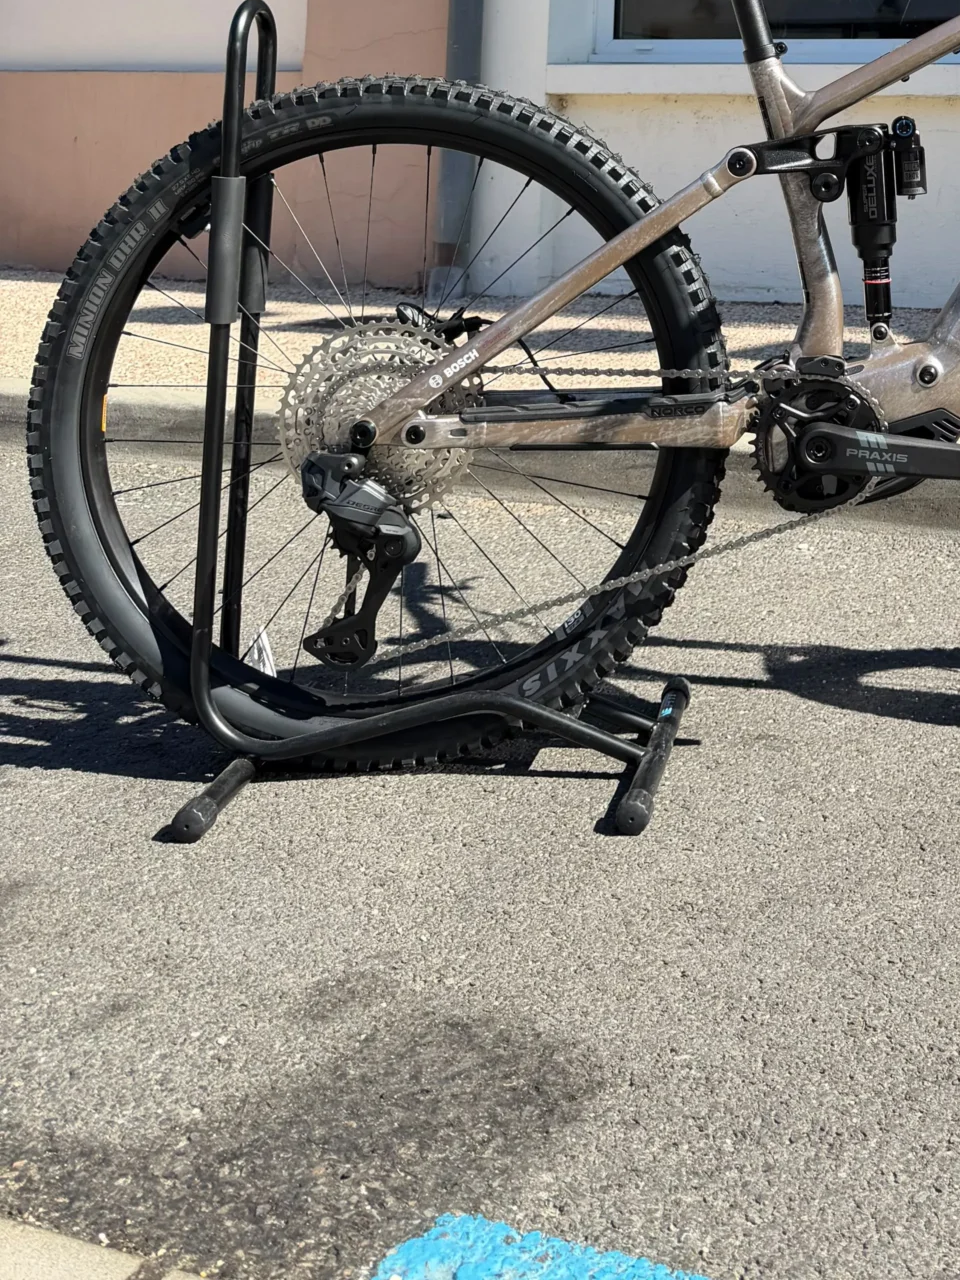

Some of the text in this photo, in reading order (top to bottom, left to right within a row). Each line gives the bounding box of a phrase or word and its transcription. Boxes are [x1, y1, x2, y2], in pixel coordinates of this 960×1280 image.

[863, 154, 878, 219] DELUXE
[66, 267, 115, 360] MINION
[108, 220, 150, 272] DHR
[443, 348, 480, 378] BOSCH
[650, 404, 706, 418] NORCO
[846, 447, 909, 463] PRAXIS
[521, 618, 611, 698] XXIS
